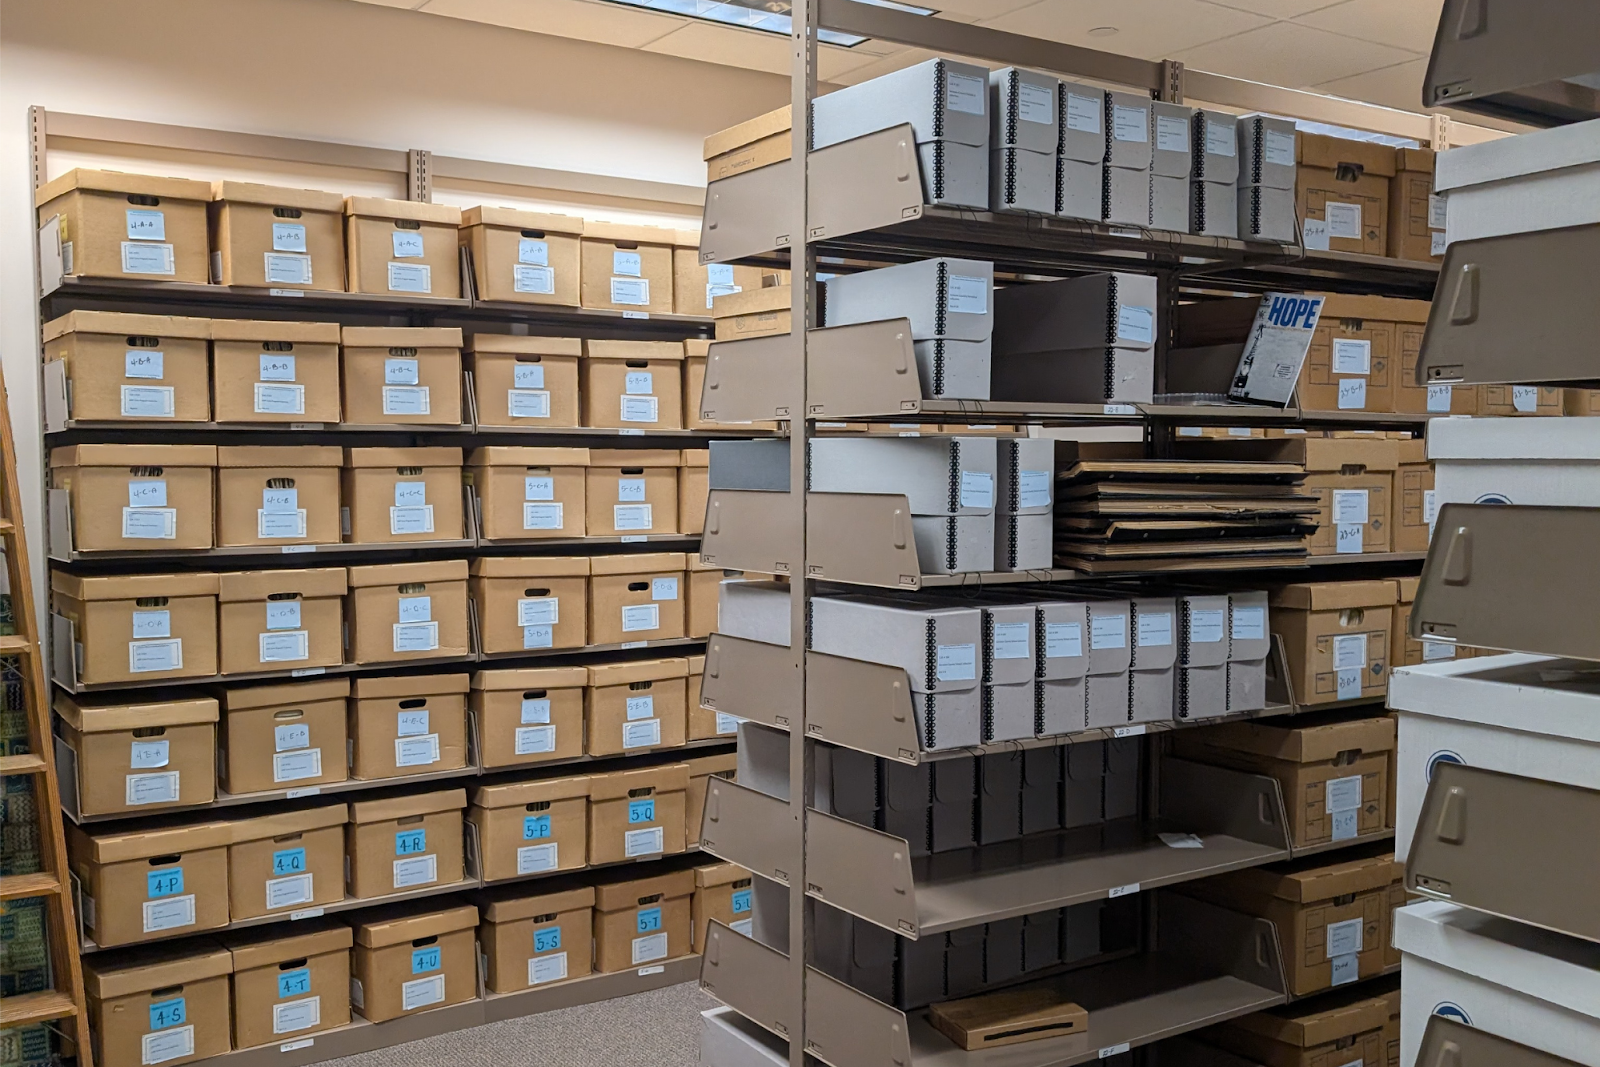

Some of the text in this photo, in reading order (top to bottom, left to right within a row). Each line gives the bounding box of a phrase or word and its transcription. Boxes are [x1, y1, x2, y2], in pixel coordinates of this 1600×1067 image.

[131, 221, 154, 229] 4-A-A
[1268, 296, 1321, 329] HOPE
[131, 356, 151, 366] 4-B-A
[133, 487, 157, 497] 4-C-A
[529, 482, 548, 490] 5-C-A
[621, 485, 642, 493] 5-C-B
[399, 490, 422, 498] 4-C-C
[631, 807, 653, 821] 5-Q
[526, 824, 548, 838] 5-P
[399, 837, 422, 852] 4-R
[277, 856, 300, 870] 4-Q
[154, 878, 179, 892] 4-P
[640, 916, 659, 930] 5-T
[536, 935, 558, 950] 5-S
[416, 954, 437, 969] 4-U
[283, 977, 306, 992] 4-T
[157, 1007, 181, 1025] 4-S
